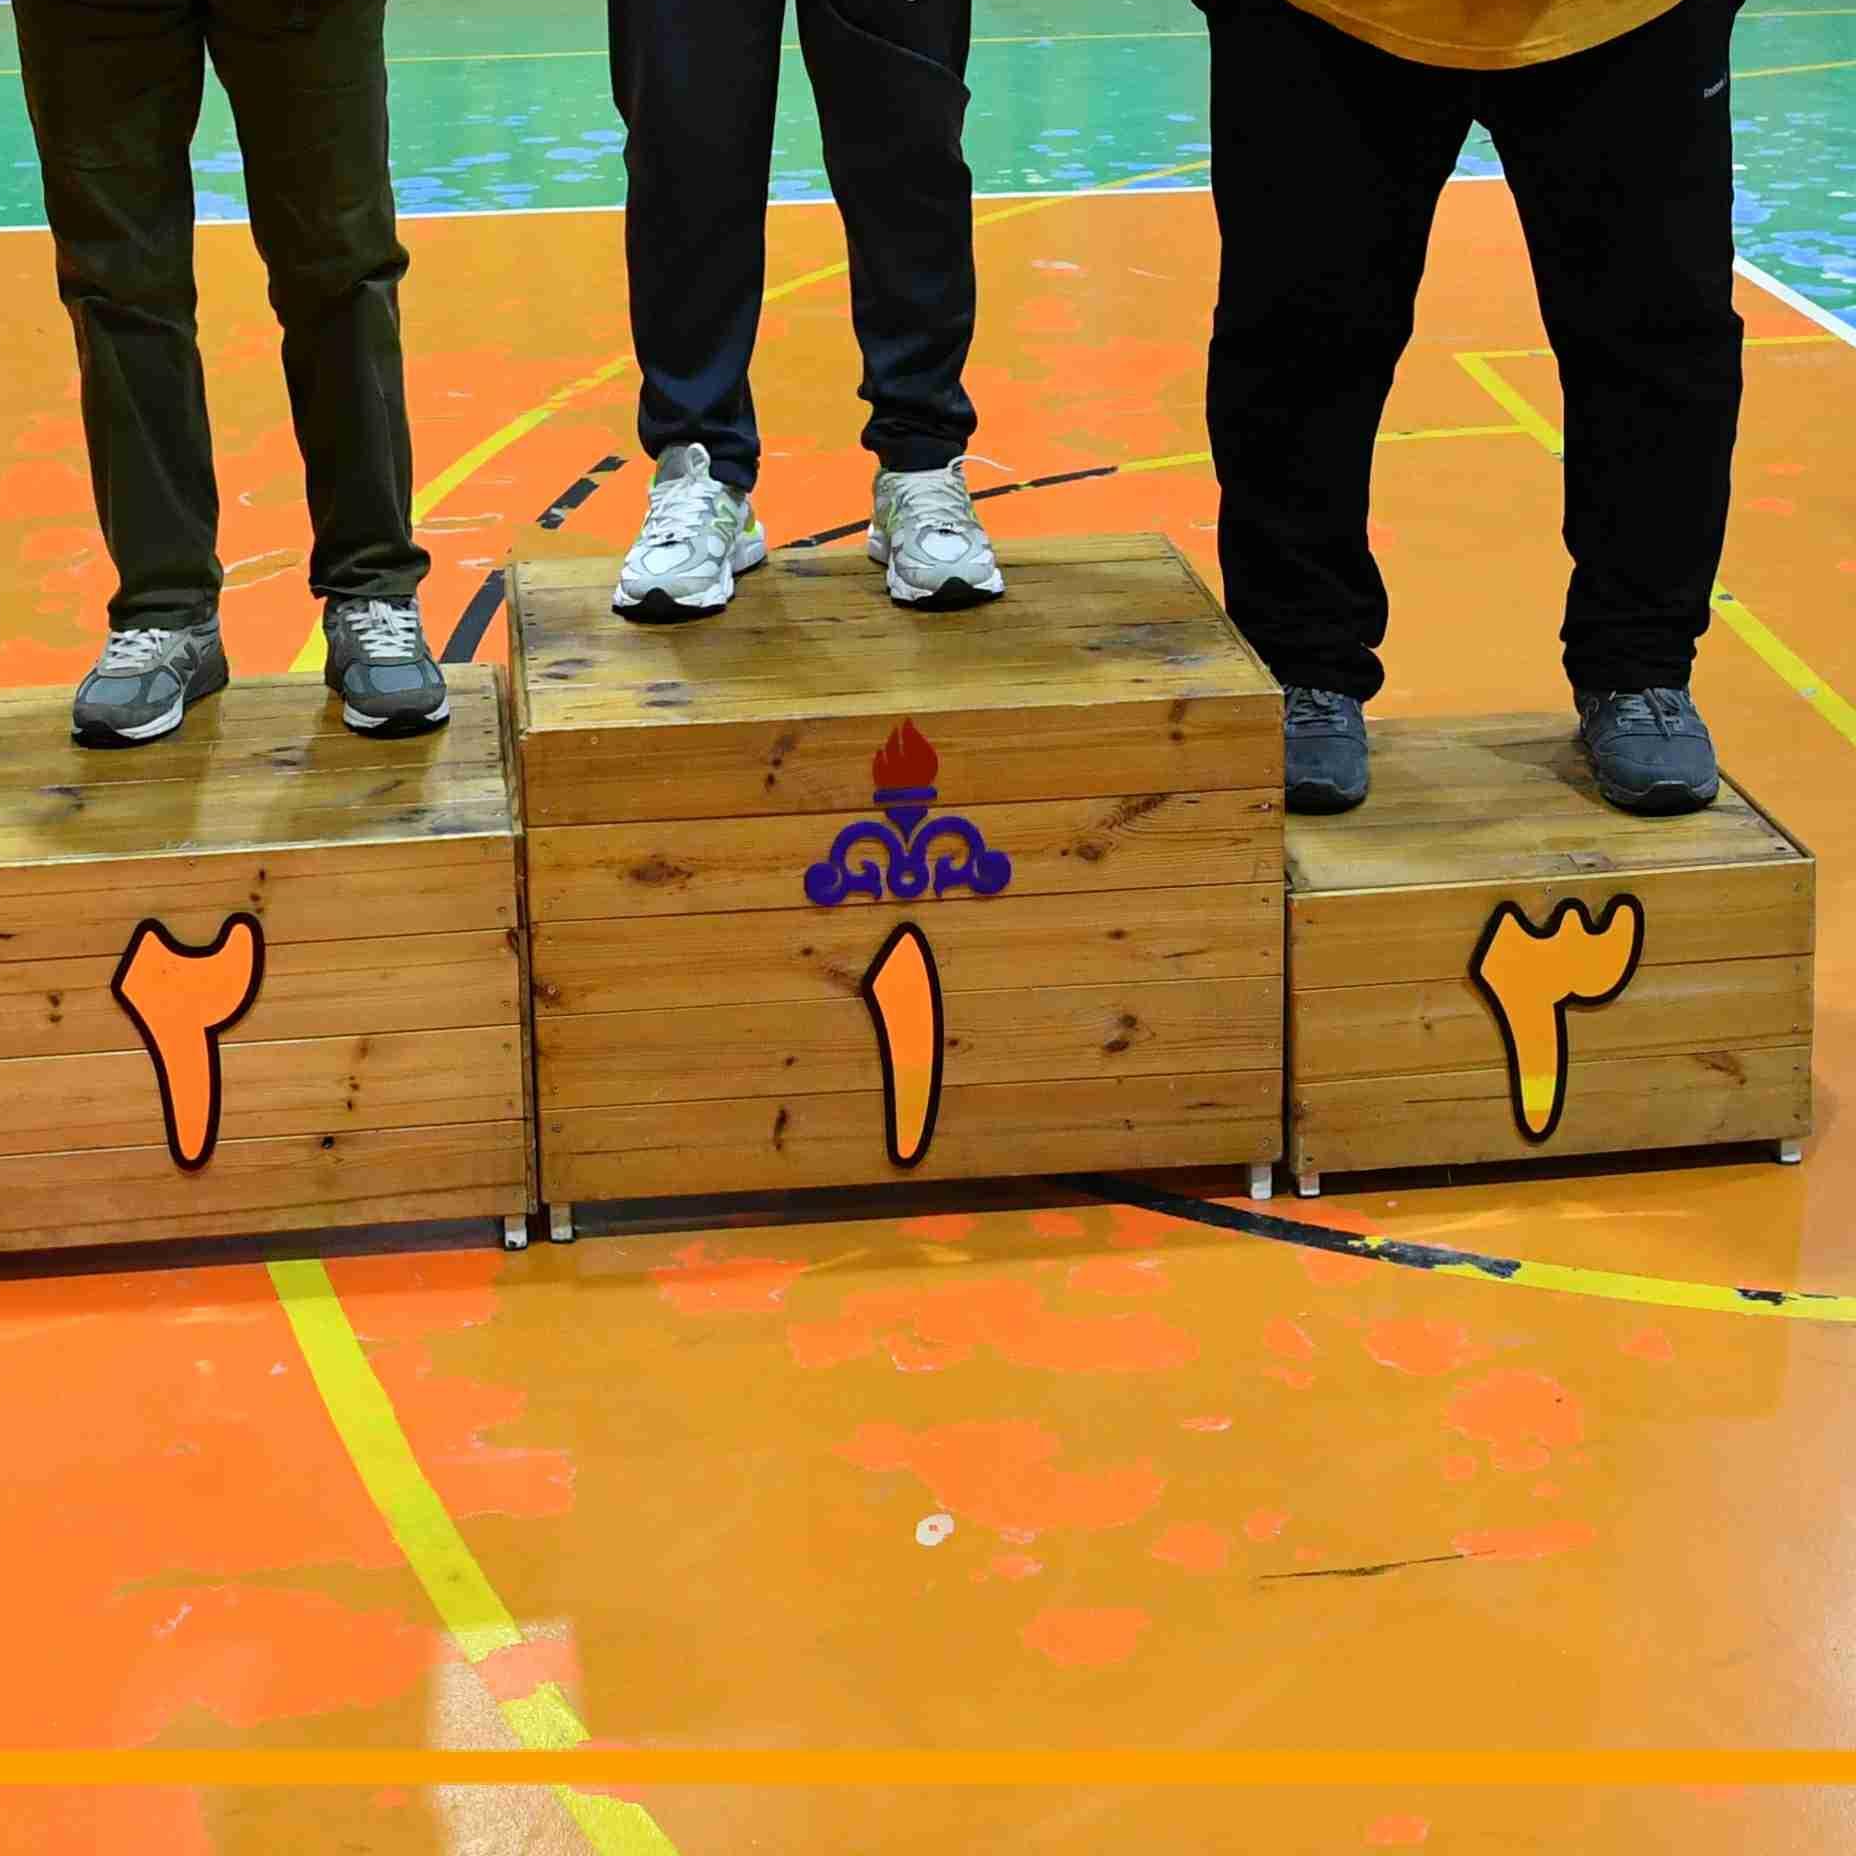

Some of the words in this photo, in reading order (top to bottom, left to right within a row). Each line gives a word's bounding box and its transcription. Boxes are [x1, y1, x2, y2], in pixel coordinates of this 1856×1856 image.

[111, 910, 265, 1171] ۲
[860, 919, 946, 1169] ۱
[1469, 892, 1644, 1144] ۳
